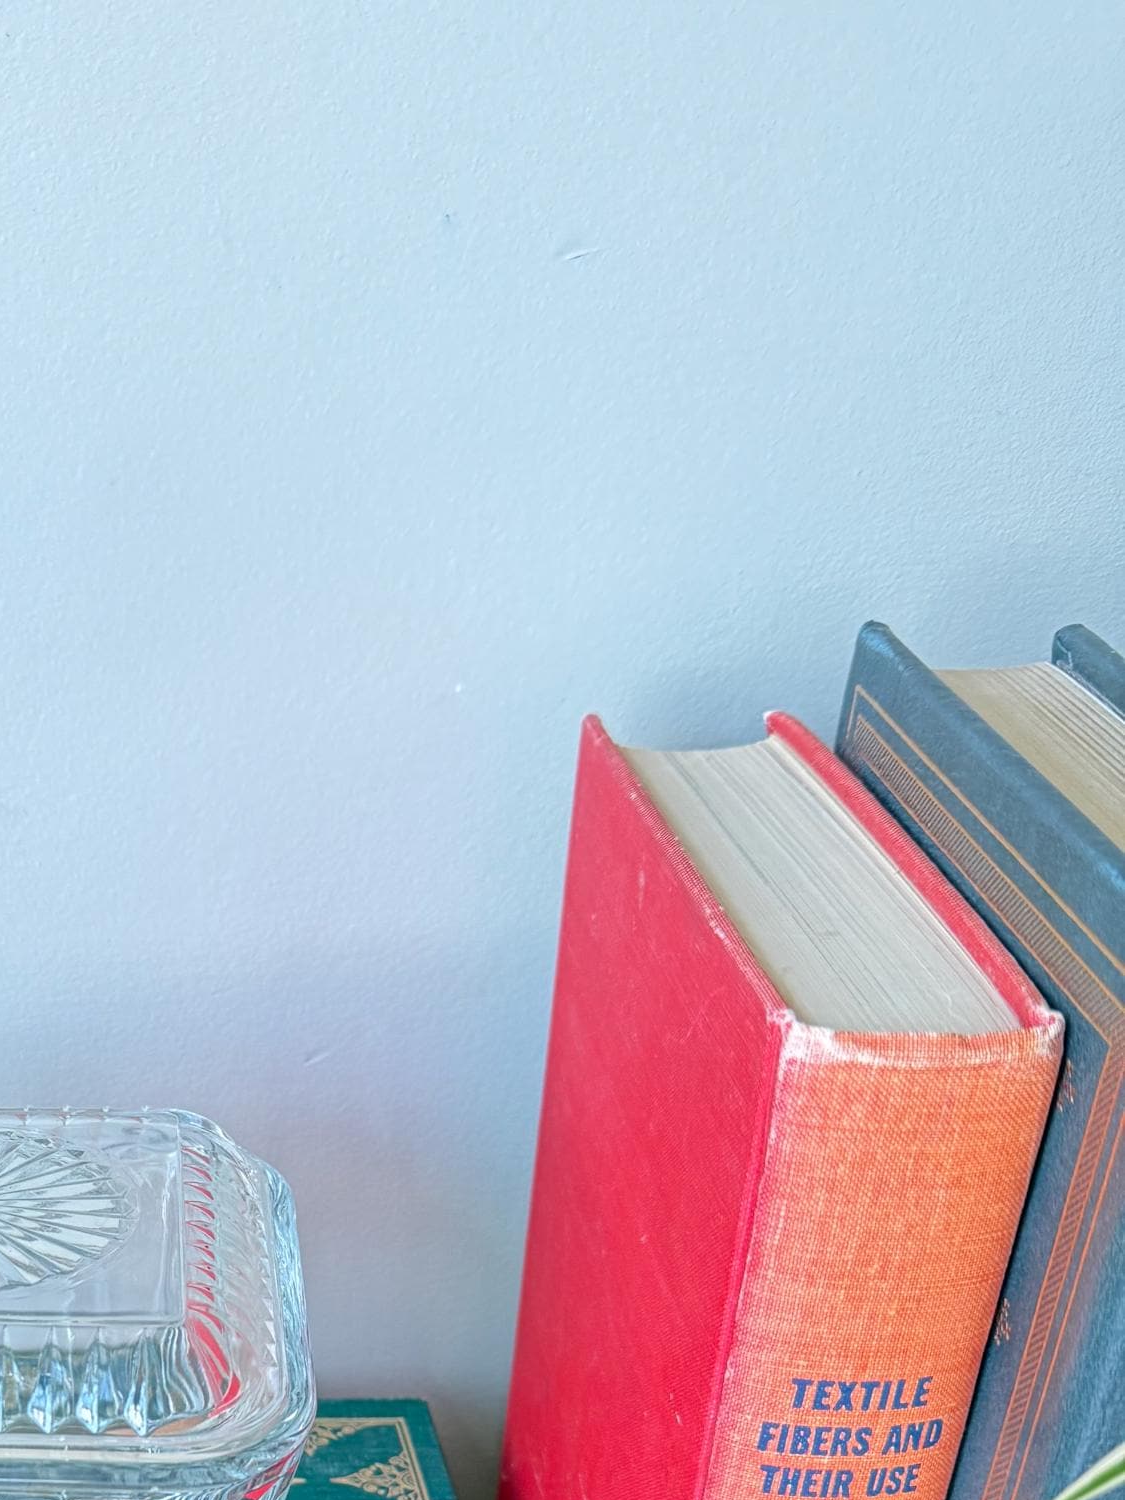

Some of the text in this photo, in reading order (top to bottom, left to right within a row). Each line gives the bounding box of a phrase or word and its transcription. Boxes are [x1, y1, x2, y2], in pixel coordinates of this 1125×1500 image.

[791, 1376, 933, 1411] TEXTILE
[757, 1418, 943, 1456] FIBERS AND
[760, 1463, 921, 1498] THEIR USE
